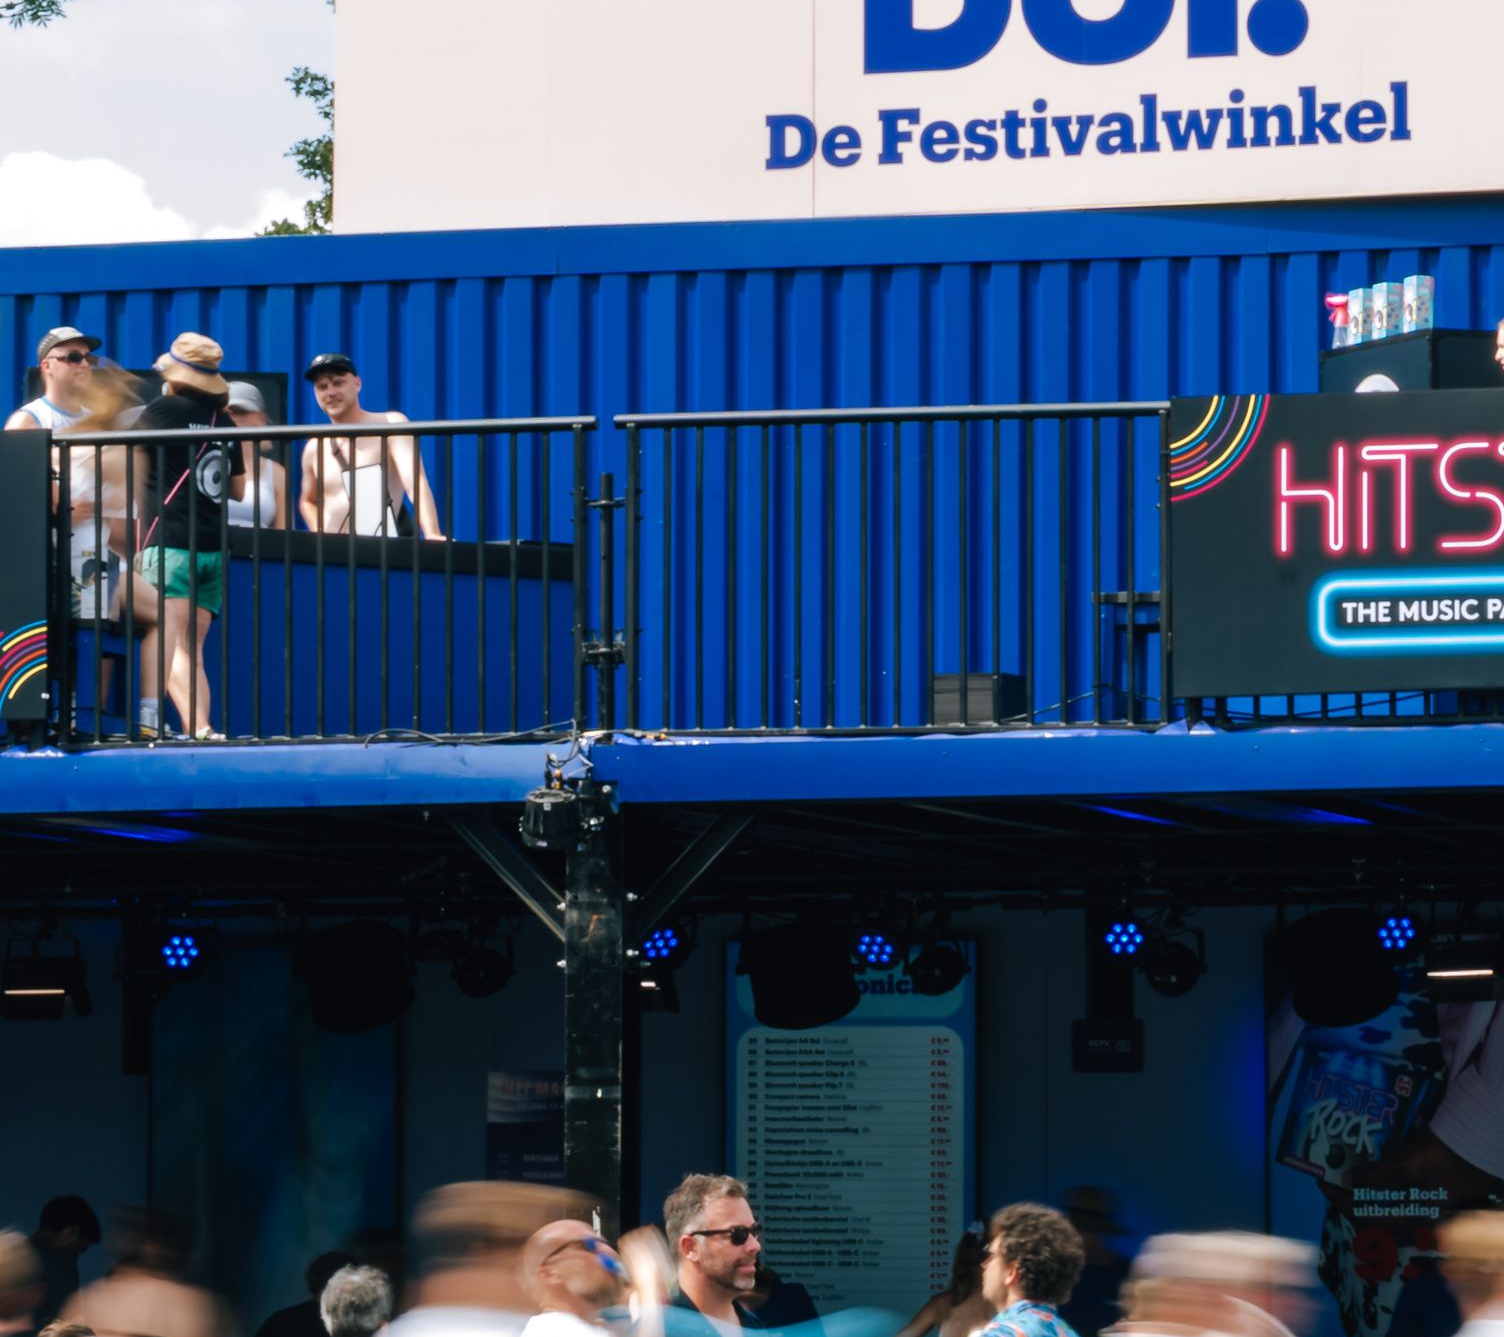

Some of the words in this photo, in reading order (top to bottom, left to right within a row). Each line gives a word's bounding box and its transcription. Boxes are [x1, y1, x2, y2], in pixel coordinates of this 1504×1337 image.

[765, 113, 862, 171] De
[877, 81, 1411, 166] Festivalwinkel
[1342, 600, 1392, 624] THE
[1398, 597, 1481, 623] MUSIC
[1305, 1067, 1399, 1129] HITSTER
[1353, 1187, 1407, 1201] Hitster
[1409, 1186, 1449, 1201] Rock
[1353, 1204, 1440, 1220] uitbreiding
